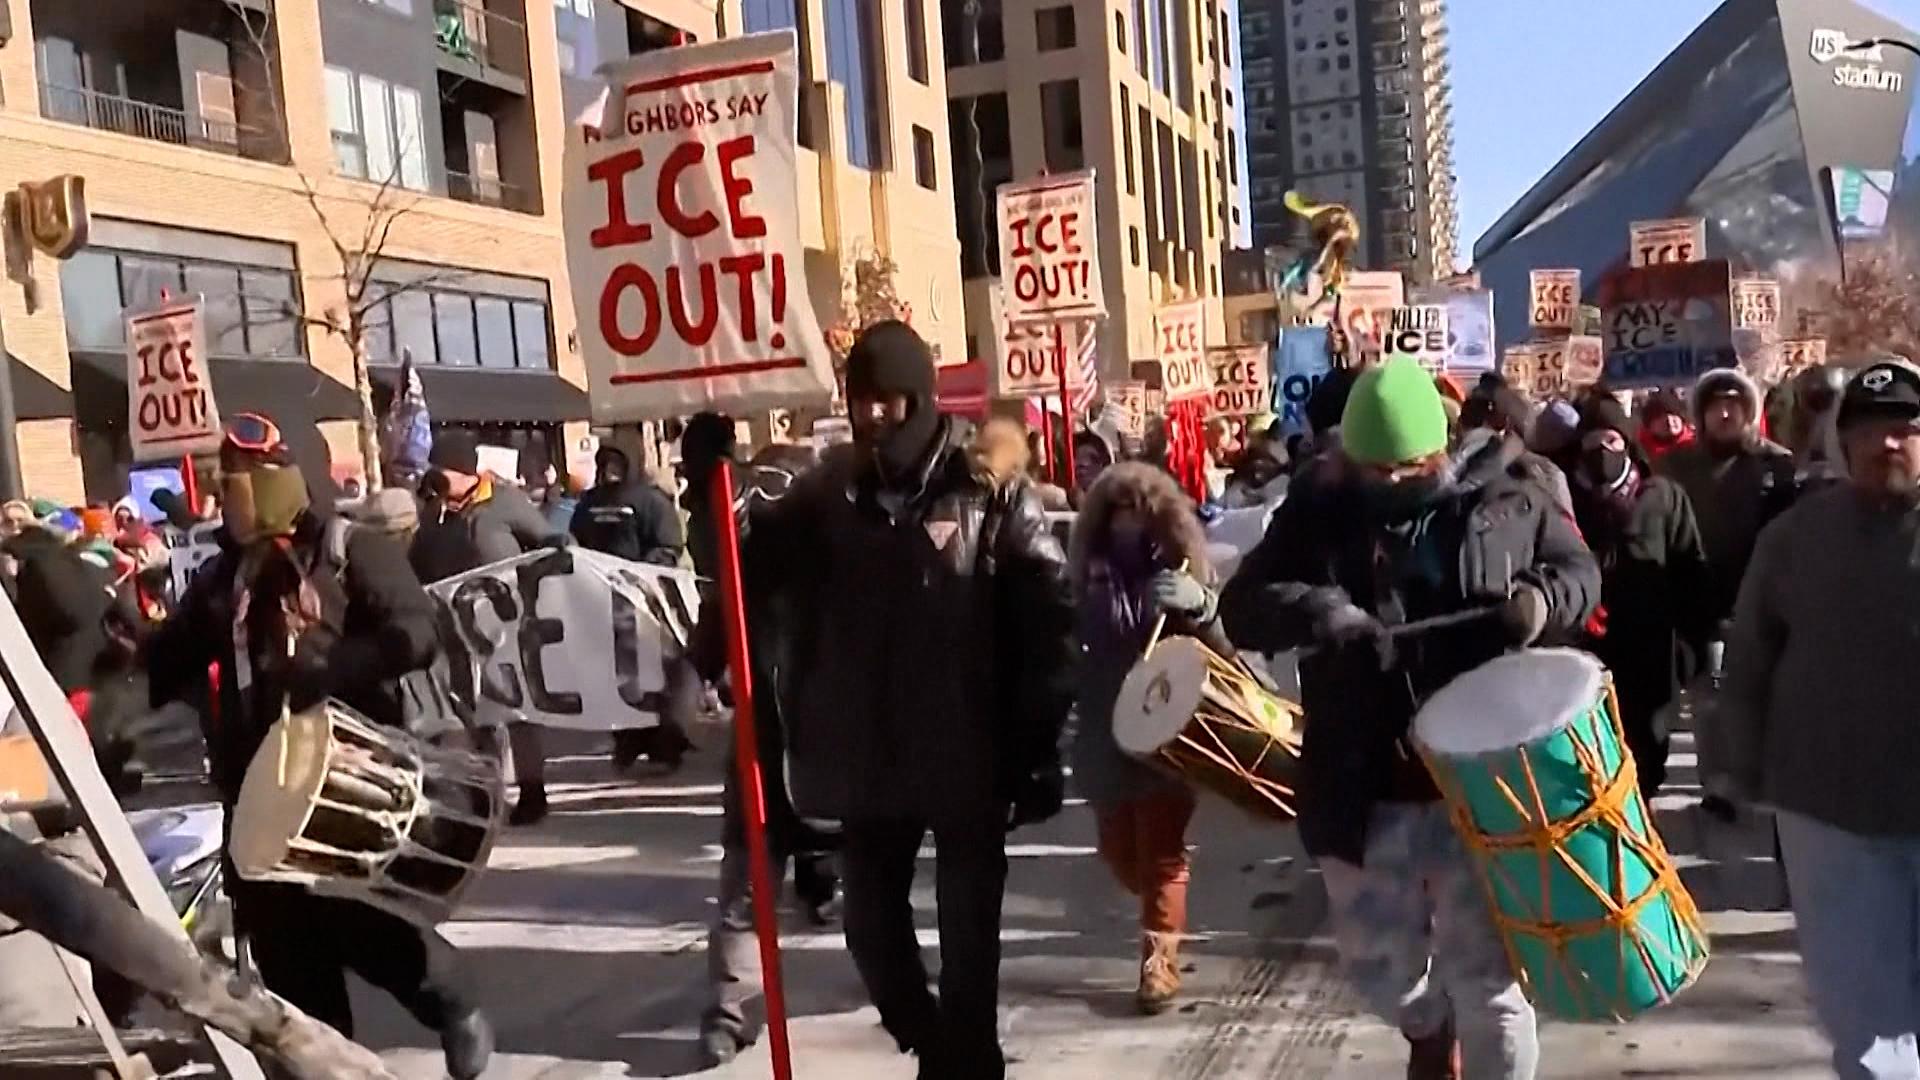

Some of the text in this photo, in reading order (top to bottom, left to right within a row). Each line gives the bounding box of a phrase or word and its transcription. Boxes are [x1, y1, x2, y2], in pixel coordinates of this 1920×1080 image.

[1832, 62, 1902, 92] stadium
[583, 92, 769, 144] NGHBORS SAY
[587, 134, 767, 248] ICE
[1009, 212, 1082, 258] ICE
[1014, 259, 1090, 302] OUT!
[1536, 284, 1573, 304] ICE
[599, 252, 788, 357] OUT!
[1612, 301, 1668, 327] MY
[1162, 323, 1199, 354] ICE
[1384, 330, 1445, 354] ICE
[1610, 322, 1677, 352] ICE
[137, 340, 199, 386] ICE
[1213, 360, 1259, 387] ICE
[138, 387, 208, 432] OUT!
[1214, 389, 1263, 412] OUT!
